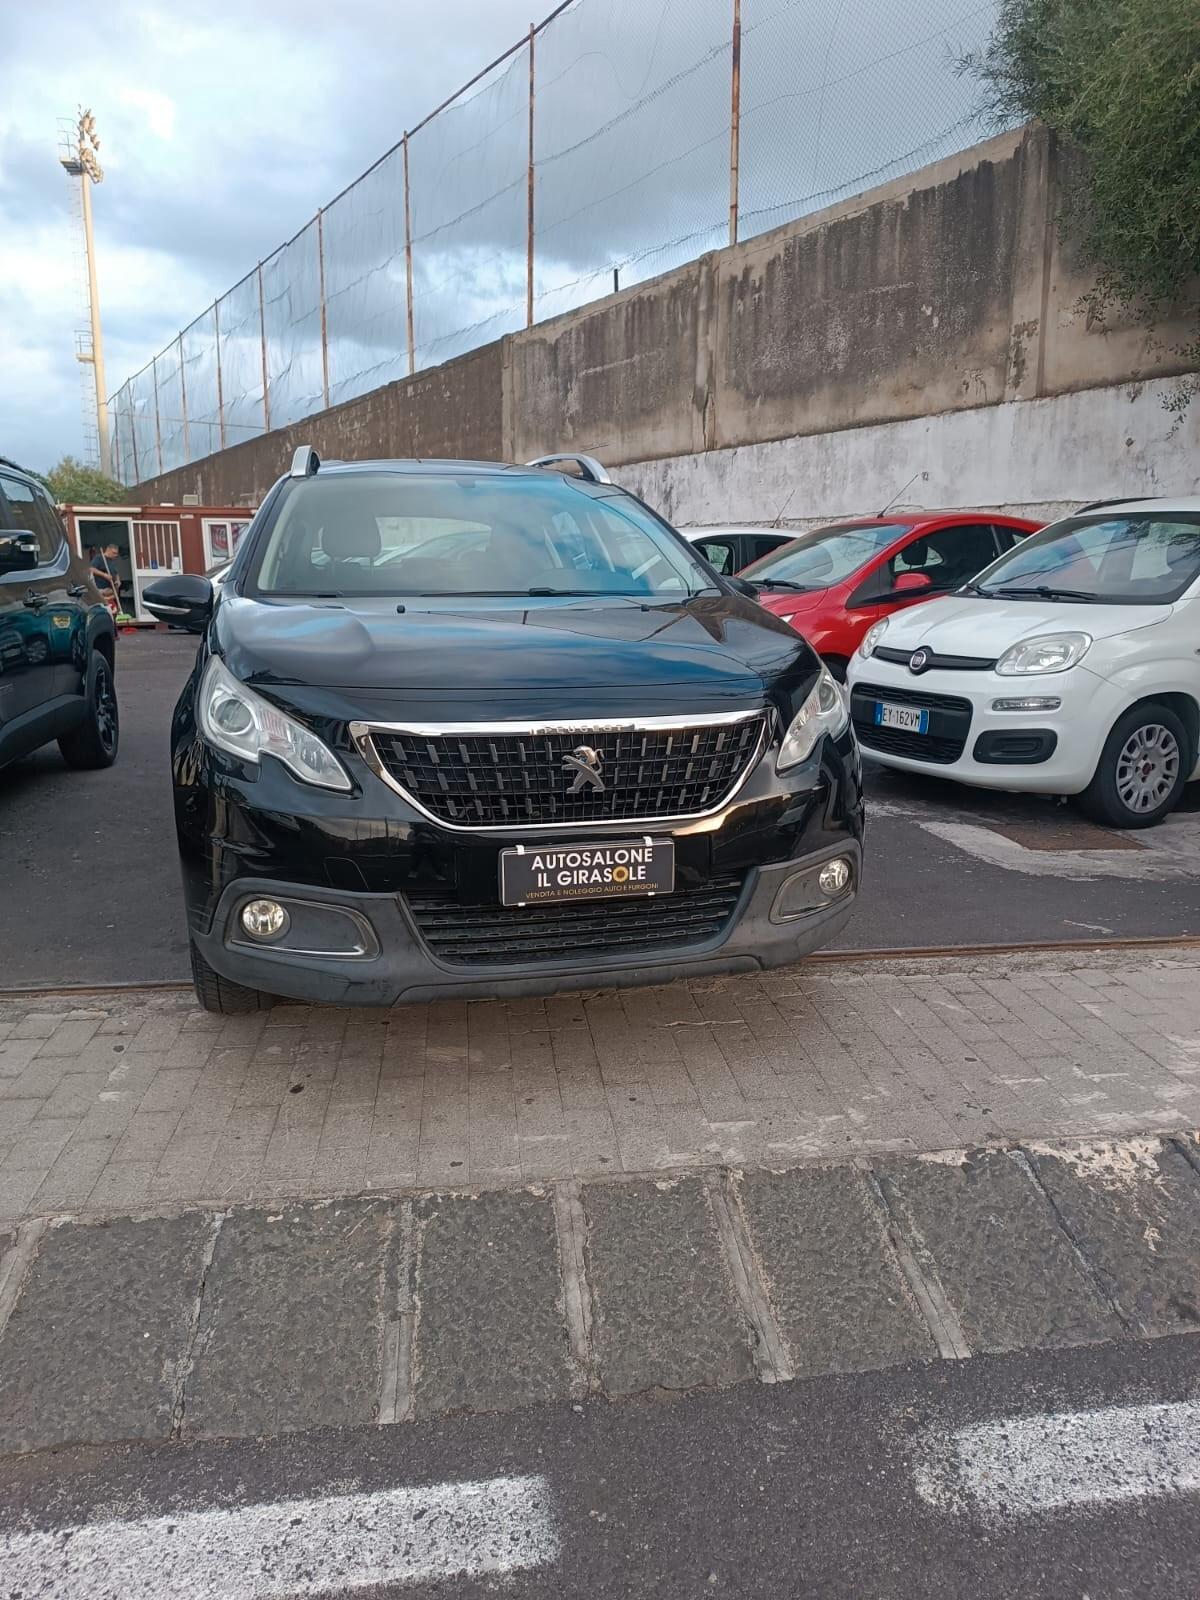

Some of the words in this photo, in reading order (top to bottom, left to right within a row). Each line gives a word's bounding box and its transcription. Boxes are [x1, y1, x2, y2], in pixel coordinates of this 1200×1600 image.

[883, 708, 892, 722] EY
[544, 724, 623, 733] PEUGEOT
[531, 848, 653, 871] AUTOSALONE
[537, 872, 551, 888] IL
[557, 865, 646, 886] GIRASOLE
[526, 890, 555, 899] VENDITA
[563, 887, 602, 896] NOLEGGIO
[604, 885, 623, 893] AUTO
[628, 883, 659, 891] FURGONI
